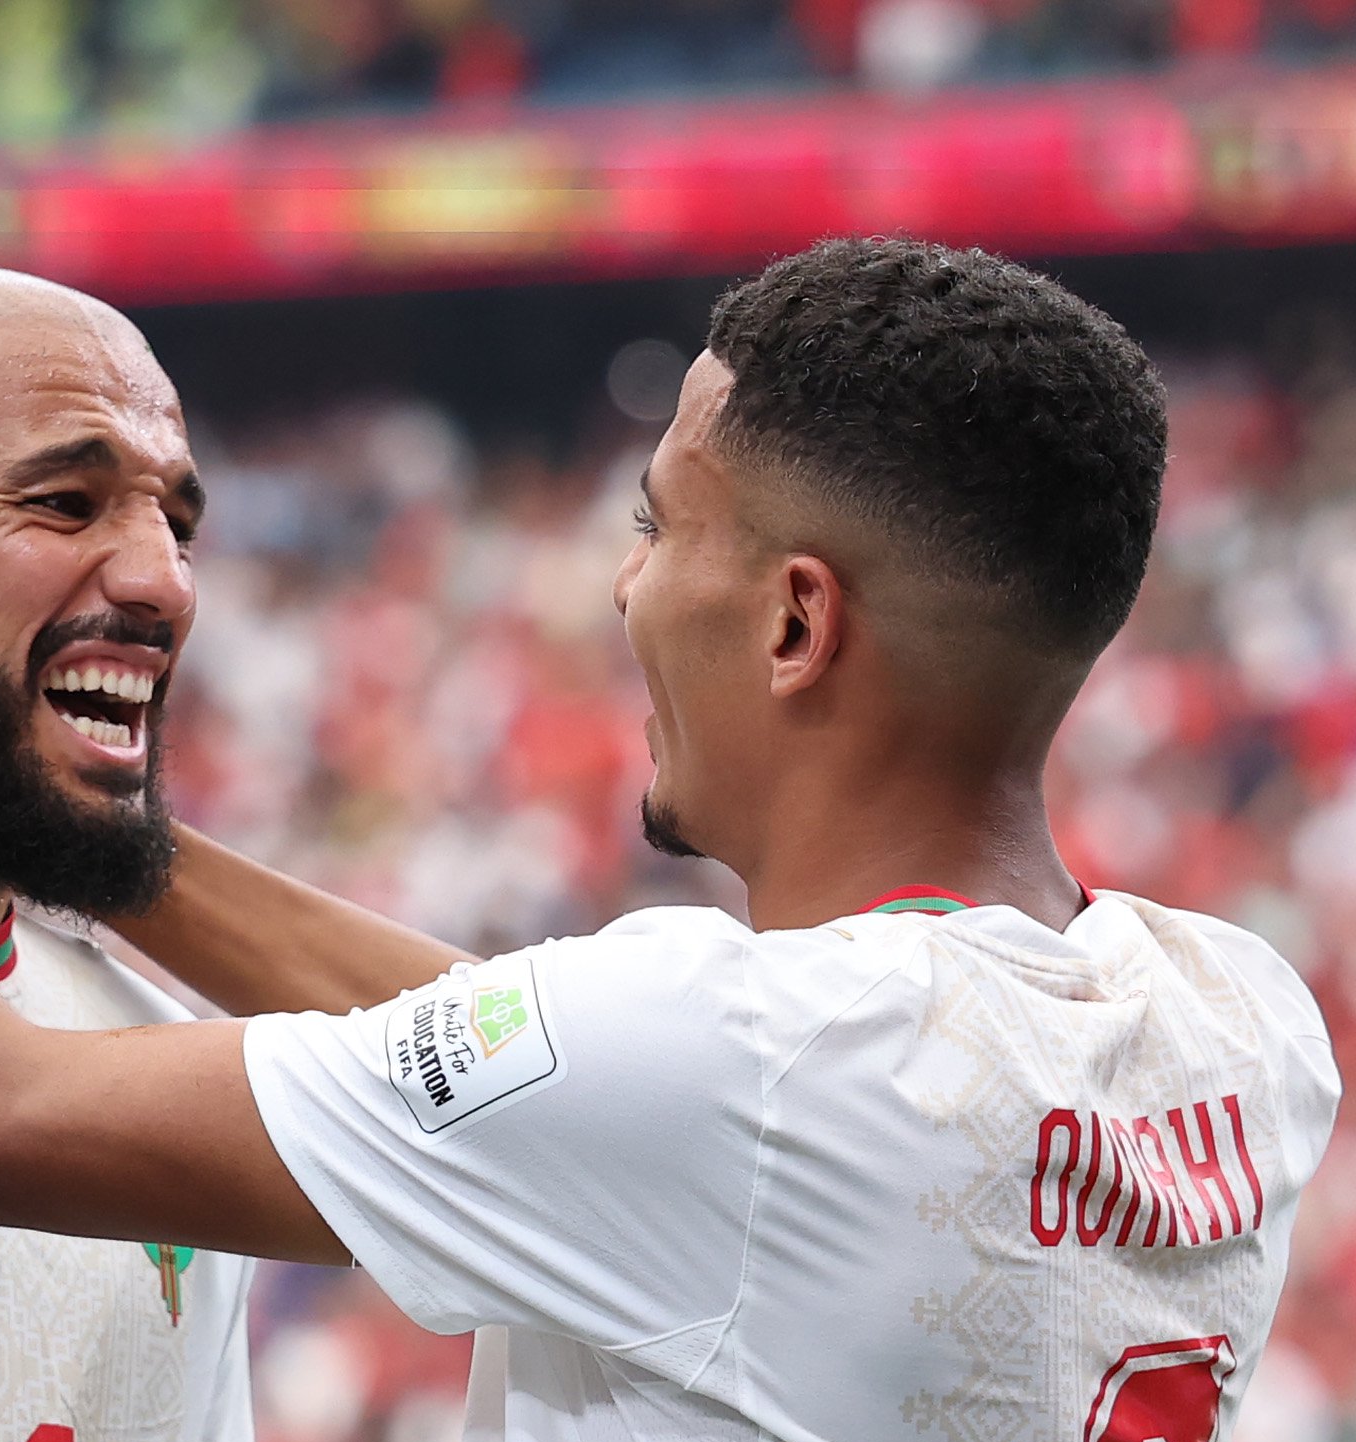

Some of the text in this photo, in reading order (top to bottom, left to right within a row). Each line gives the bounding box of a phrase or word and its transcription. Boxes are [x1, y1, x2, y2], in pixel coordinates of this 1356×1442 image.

[396, 1039, 413, 1080] FIFA
[413, 999, 455, 1108] EDUCATION
[445, 1041, 475, 1076] For
[1030, 1093, 1264, 1248] OUNAHI
